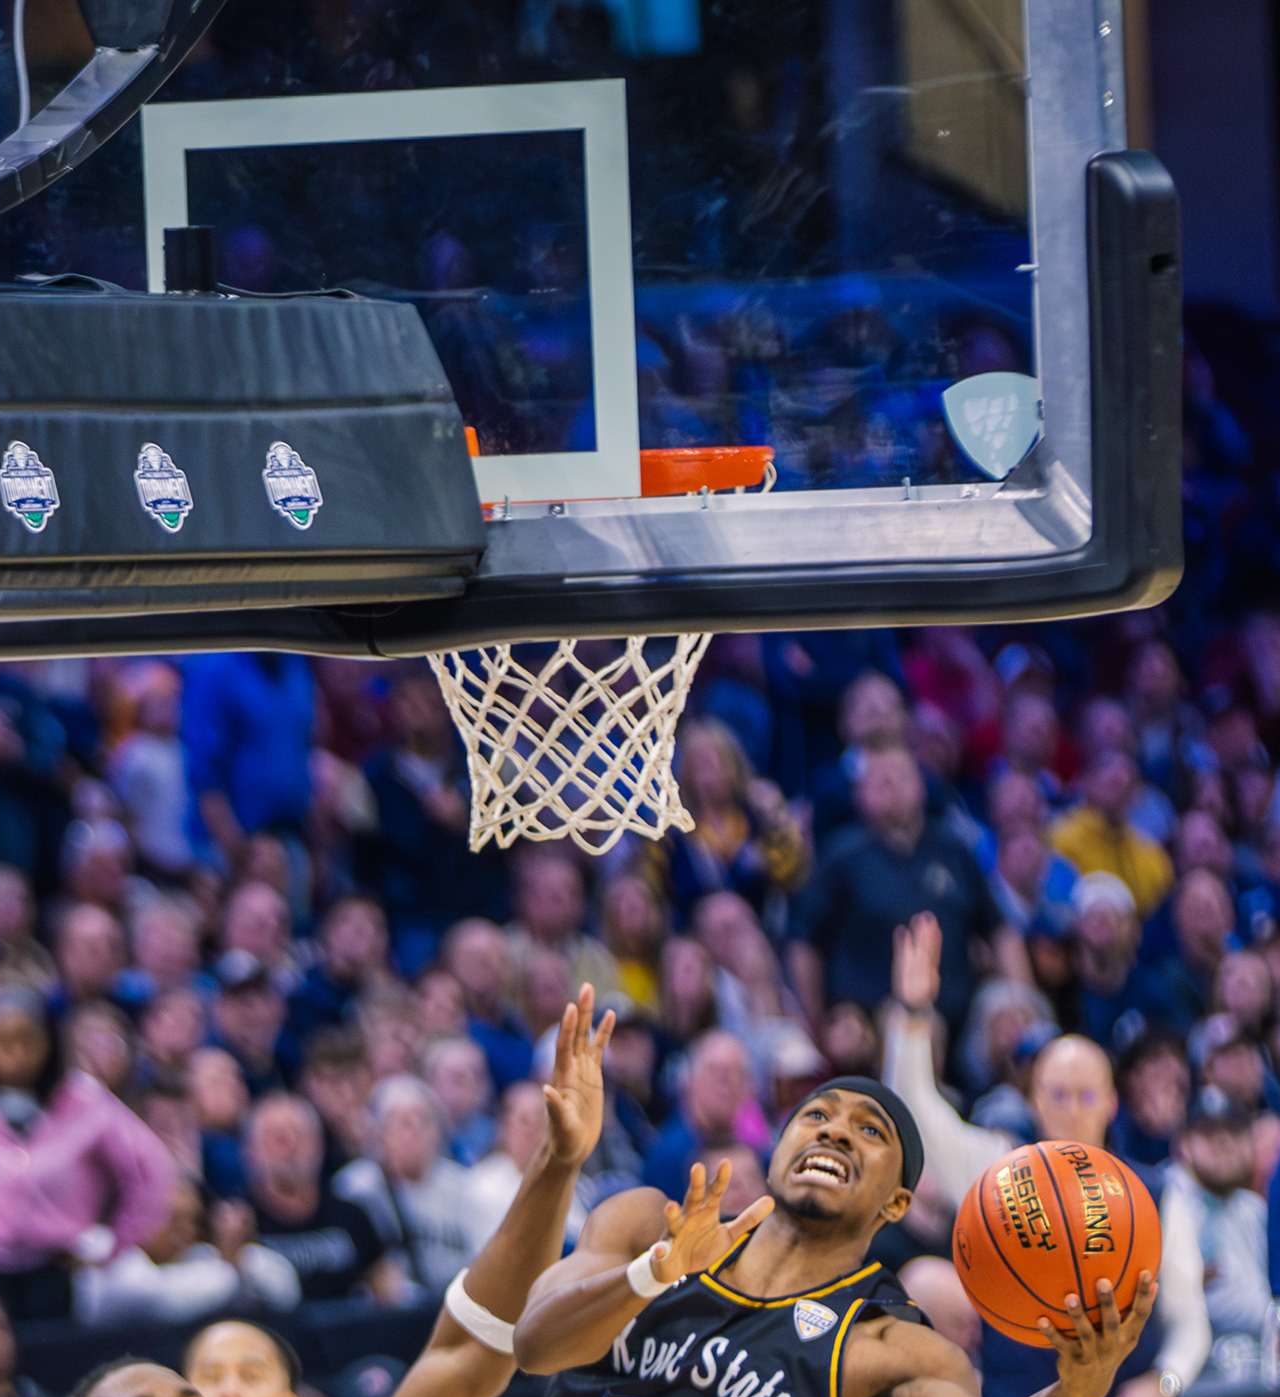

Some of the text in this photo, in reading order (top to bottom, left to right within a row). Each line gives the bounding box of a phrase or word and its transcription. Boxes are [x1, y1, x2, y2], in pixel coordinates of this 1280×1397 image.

[1012, 1154, 1058, 1251] LEGACY
[1051, 1144, 1116, 1255] SPALDING
[613, 1317, 697, 1382] Kent
